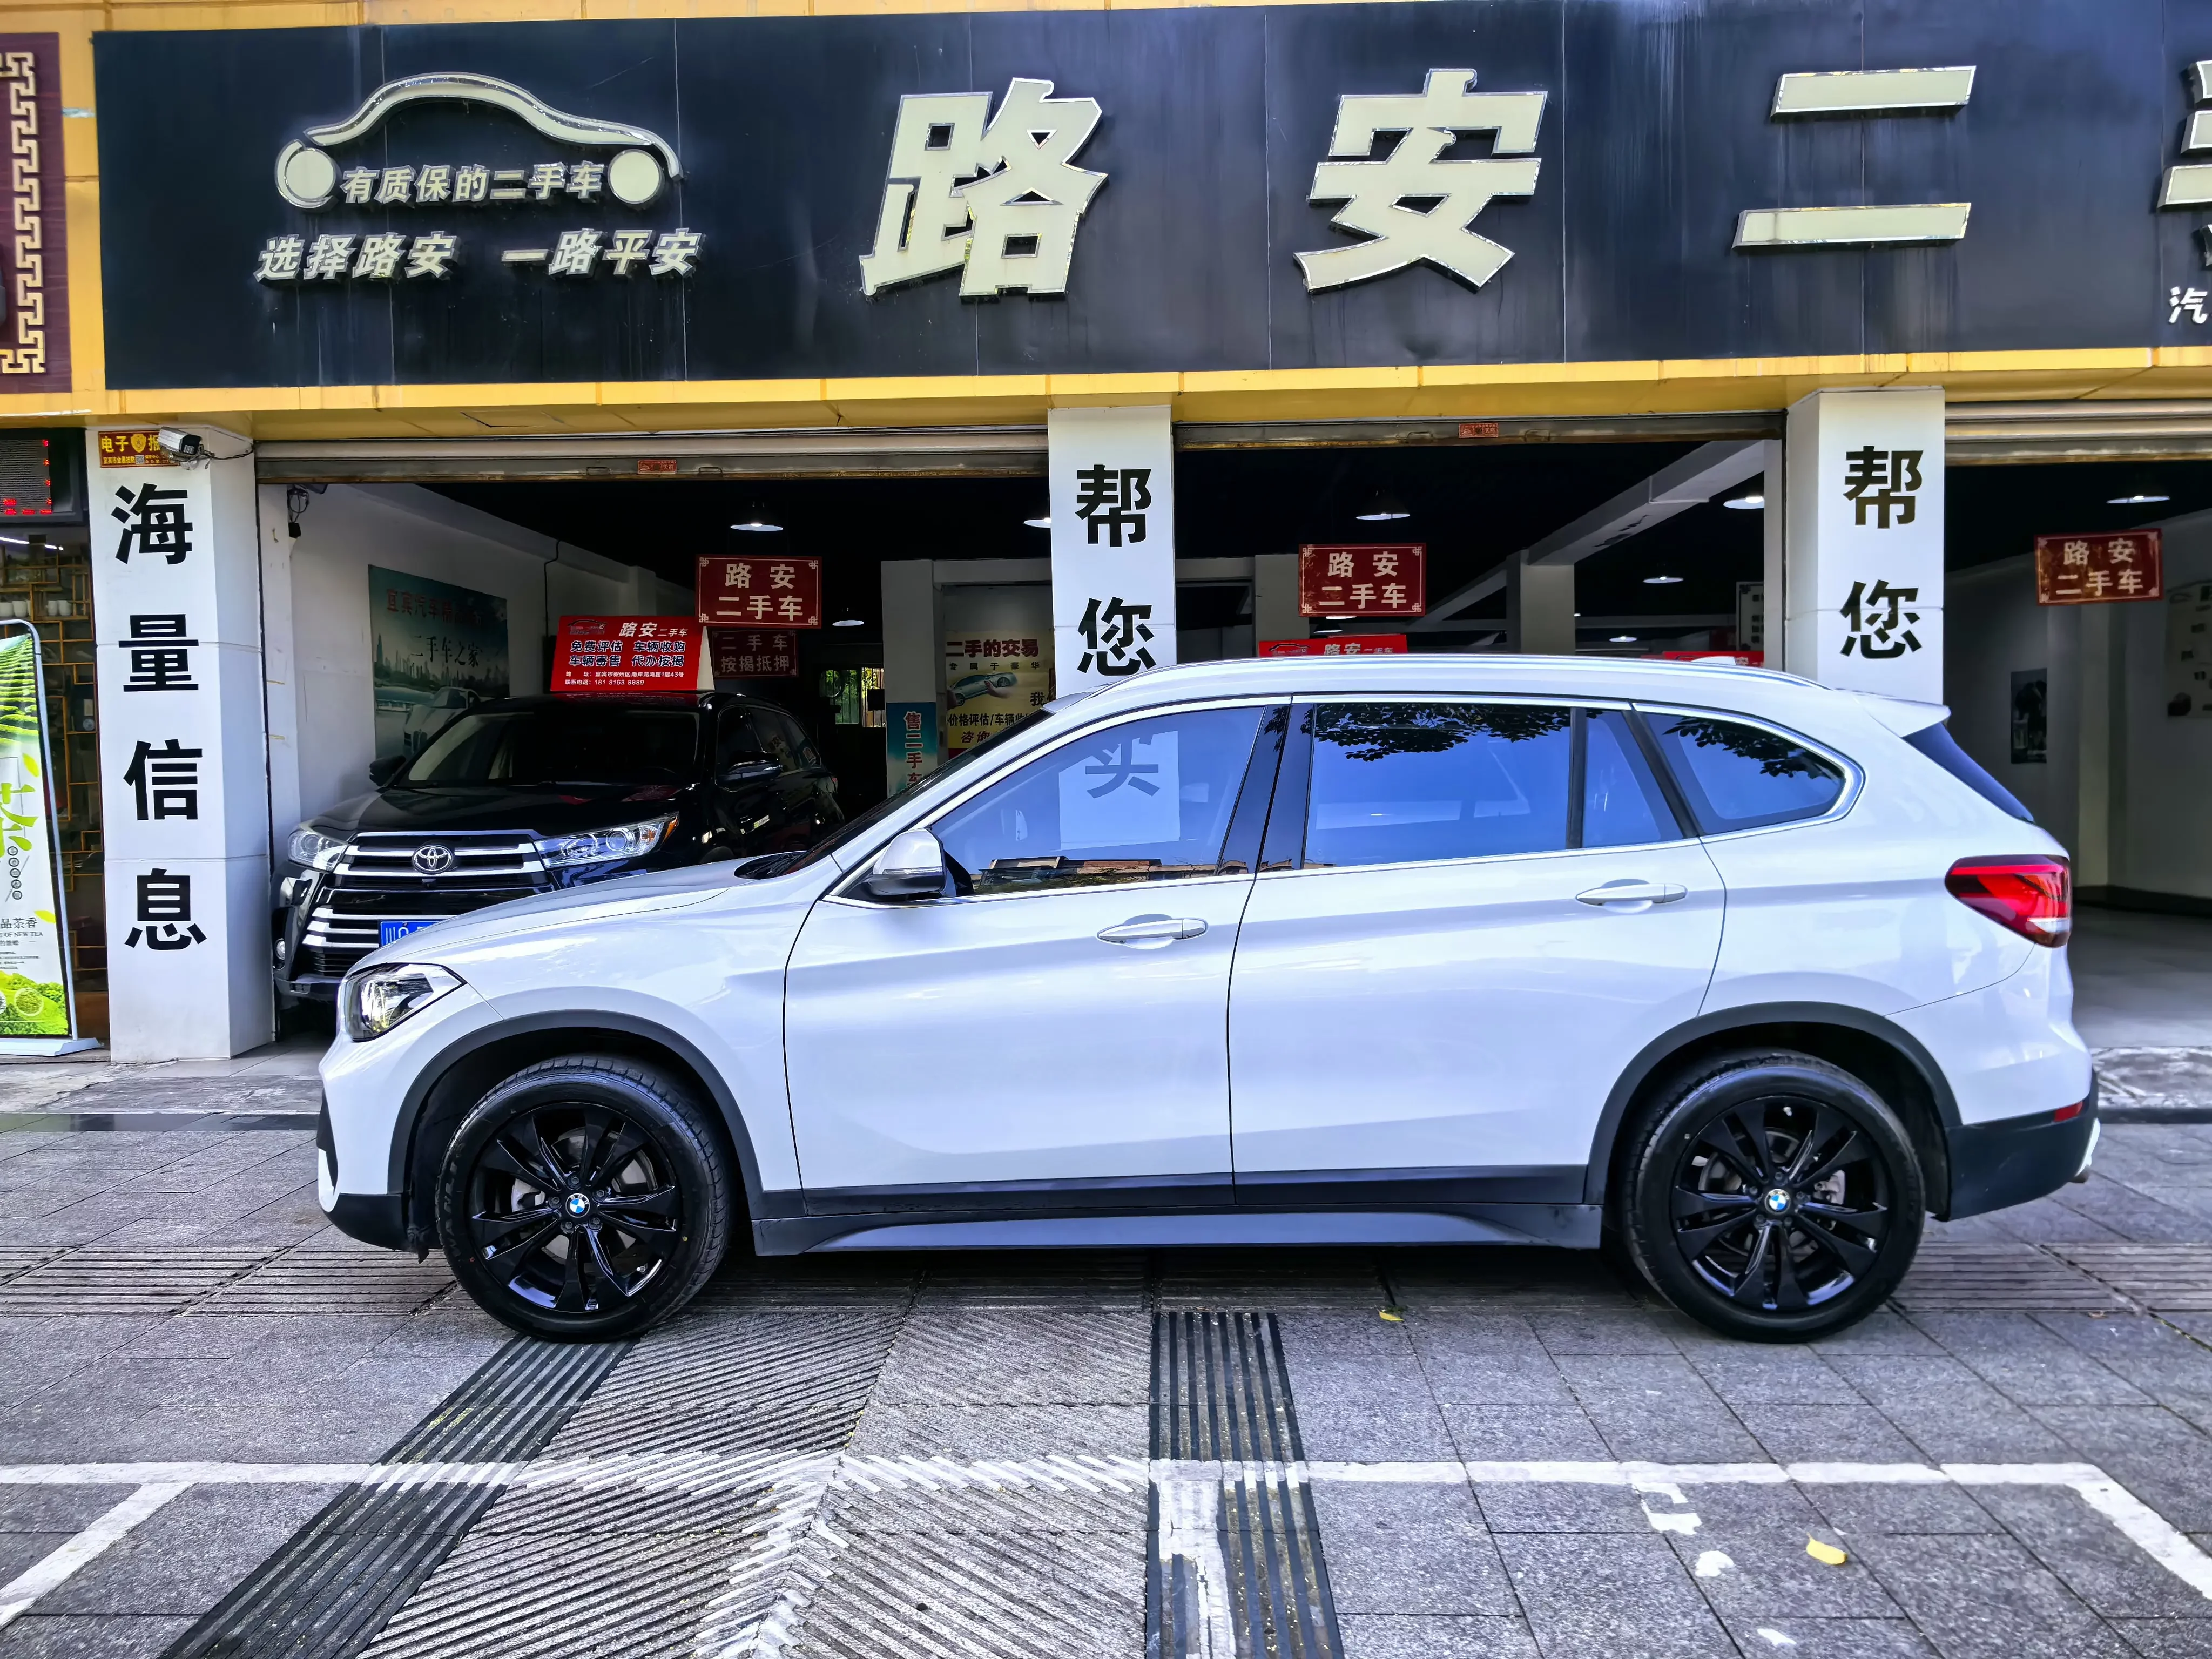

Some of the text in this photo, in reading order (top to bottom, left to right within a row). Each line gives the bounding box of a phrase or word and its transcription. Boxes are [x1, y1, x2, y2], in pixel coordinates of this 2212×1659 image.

[341, 160, 605, 205] 有质保的二手车
[254, 227, 706, 284] 选择路安 一路平安
[2168, 286, 2209, 325] 汽
[101, 435, 129, 453] 电子
[1327, 551, 1399, 577] 路安
[1839, 446, 1923, 659] 帮您
[2063, 538, 2135, 567] 路安
[724, 563, 795, 589] 路安
[2055, 570, 2143, 596] 二手车
[716, 595, 804, 621] 二手车
[1319, 583, 1407, 609] 二手车
[570, 640, 686, 653] 免费评估 车辆收购
[721, 633, 788, 652] 二手车
[946, 639, 1039, 658] 二手的交易
[569, 655, 684, 667] 车辆寄售 代办按揭
[720, 655, 790, 673] 按揭抵押
[111, 483, 207, 950] 海量信息
